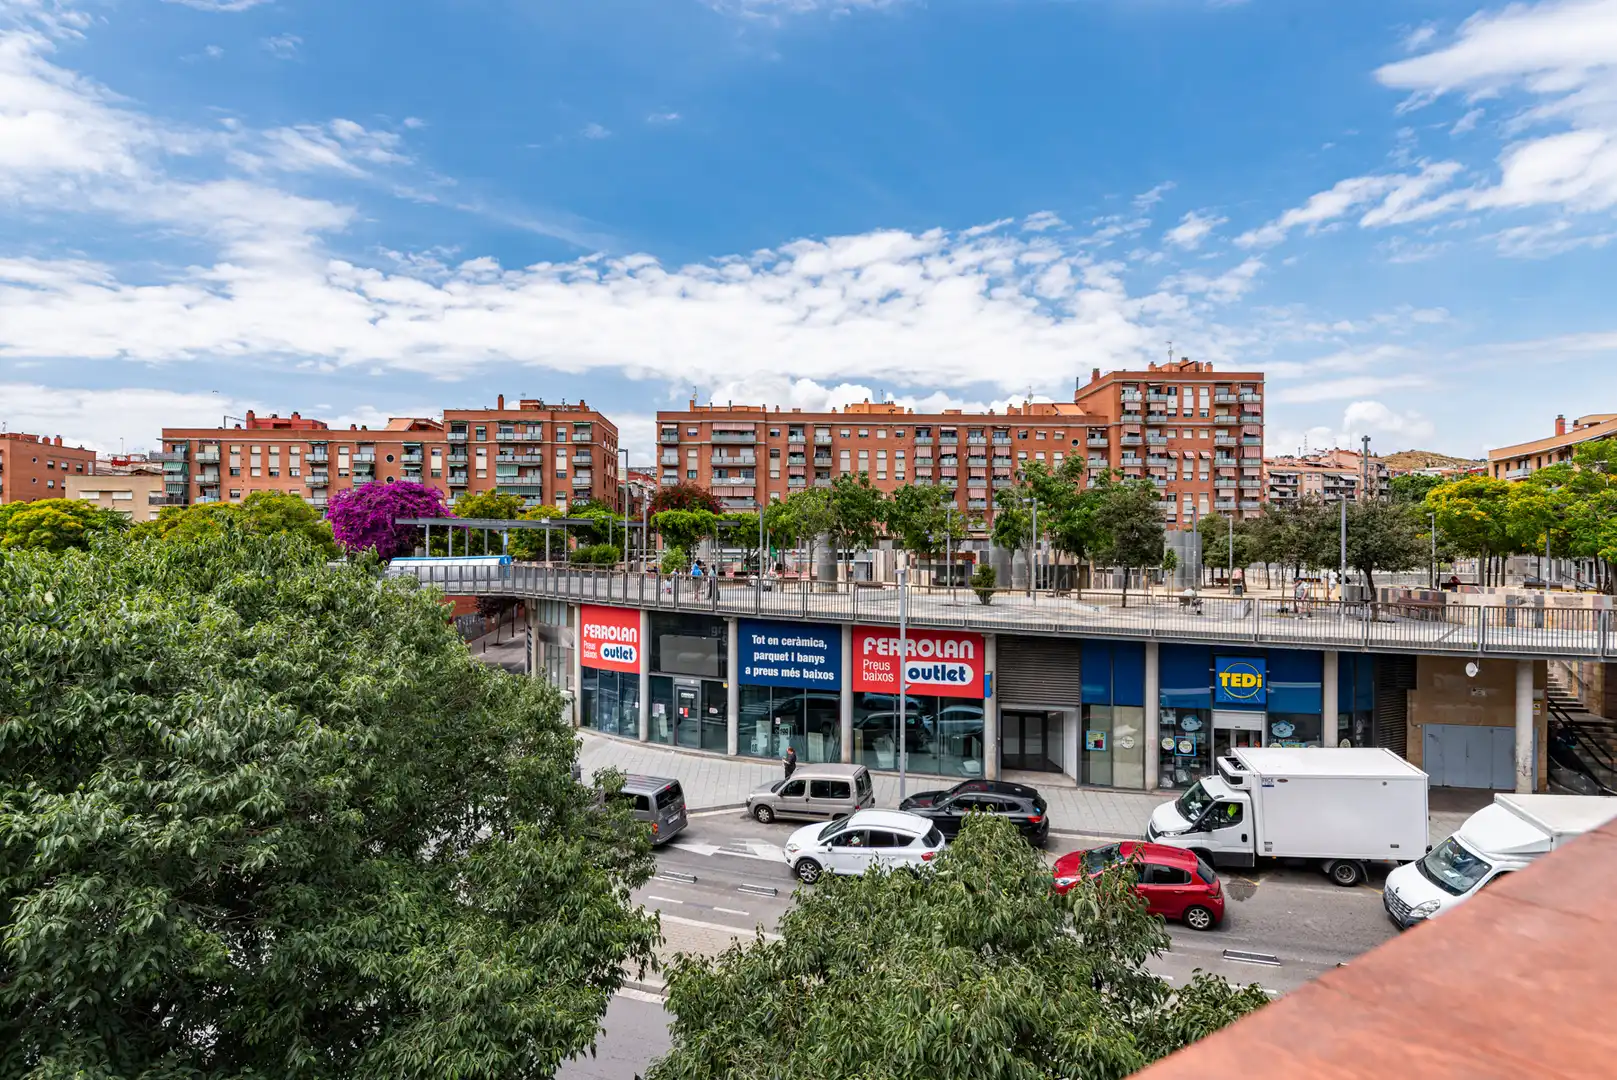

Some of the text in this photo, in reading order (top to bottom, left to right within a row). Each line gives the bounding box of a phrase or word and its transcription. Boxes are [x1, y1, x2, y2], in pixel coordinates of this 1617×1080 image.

[584, 624, 637, 642] FERROLAN
[752, 635, 828, 650] Tot en ceràmica,
[863, 637, 974, 659] FERROLAN
[603, 646, 633, 660] outlet
[753, 652, 789, 662] parquet
[797, 653, 825, 665] banys
[863, 659, 891, 671] Preus
[745, 666, 834, 680] a preus més baixos
[863, 671, 894, 682] baixos
[908, 664, 966, 682] outlet
[1219, 672, 1262, 688] TEDi
